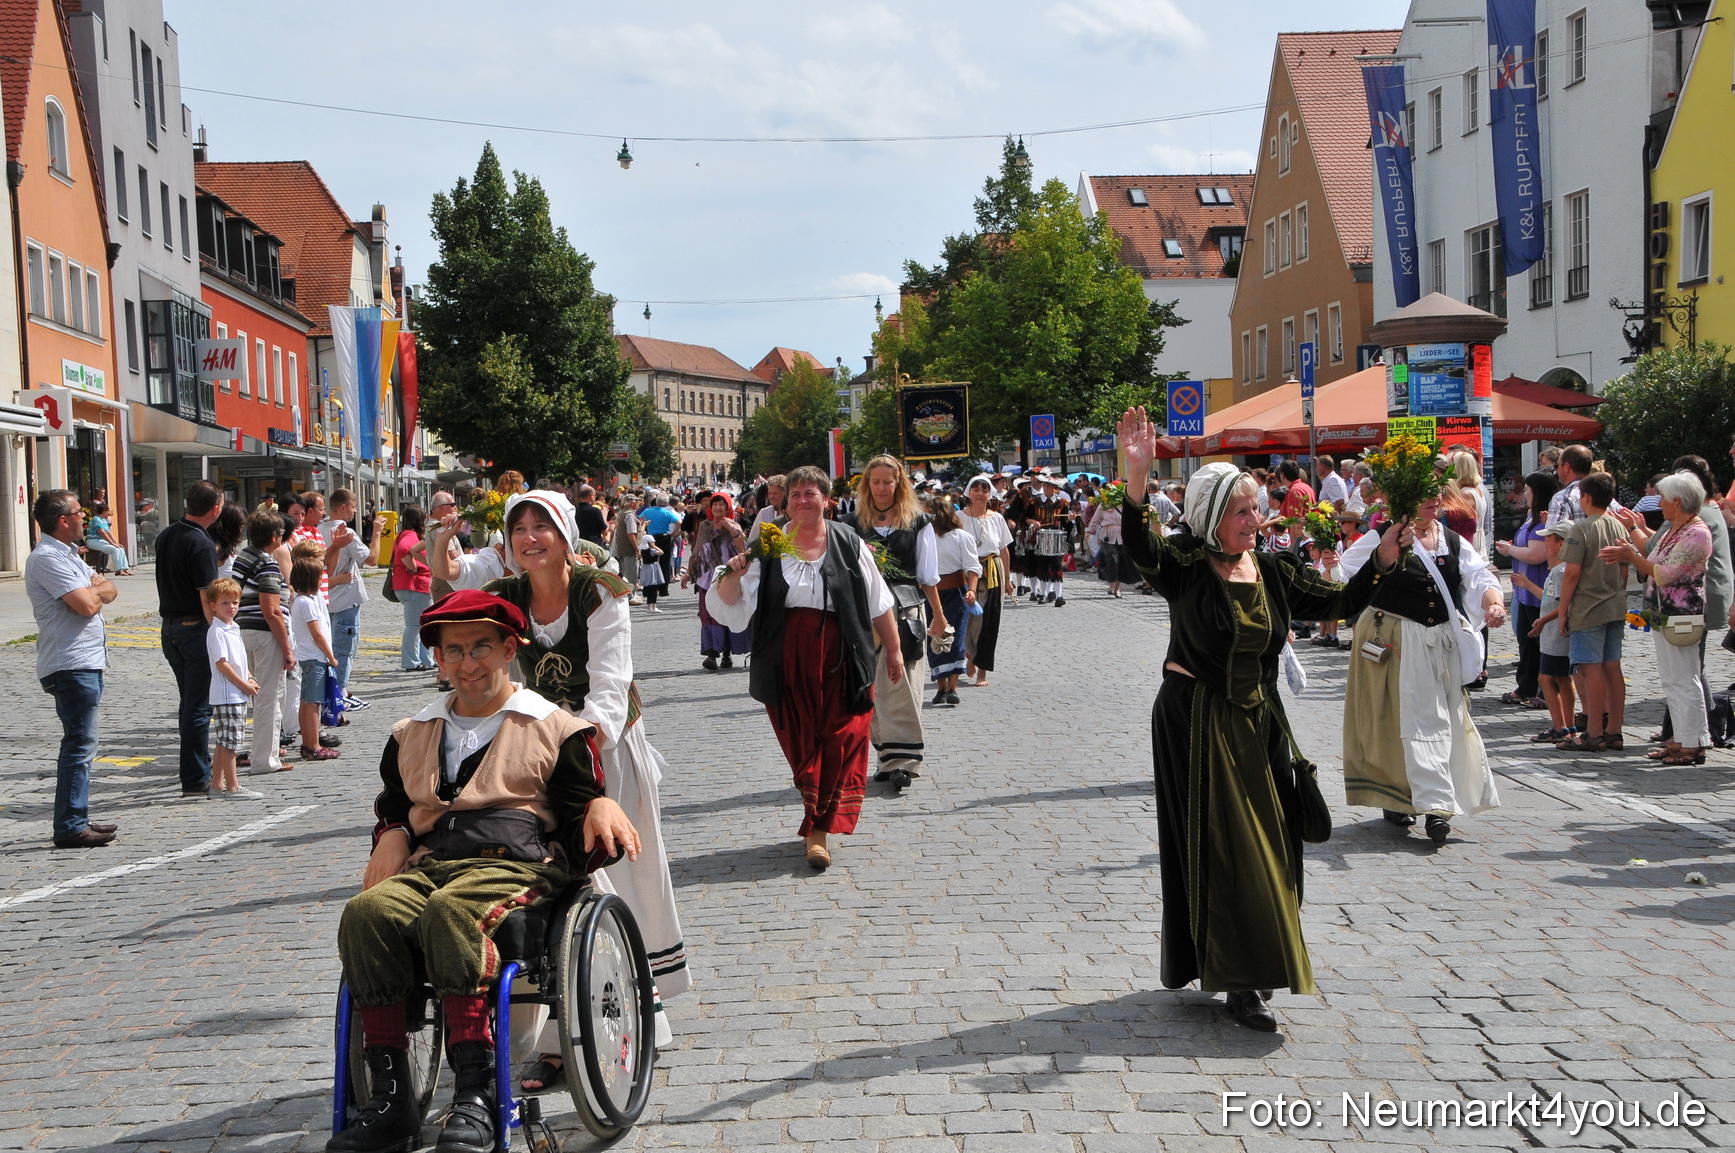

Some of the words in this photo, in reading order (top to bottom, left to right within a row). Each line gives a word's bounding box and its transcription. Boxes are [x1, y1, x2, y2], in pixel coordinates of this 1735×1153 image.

[1519, 200, 1535, 240] K&L
[1419, 349, 1442, 357] LIEDER
[1448, 348, 1460, 356] SEE
[202, 347, 238, 371] H&M
[1302, 348, 1311, 380] P
[1171, 419, 1200, 432] TAXI
[1416, 419, 1433, 428] Club
[1446, 417, 1472, 425] Kirwa
[1436, 425, 1480, 435] Sindlbach
[1524, 424, 1574, 436] Lehmeier
[1034, 438, 1053, 447] TAXI
